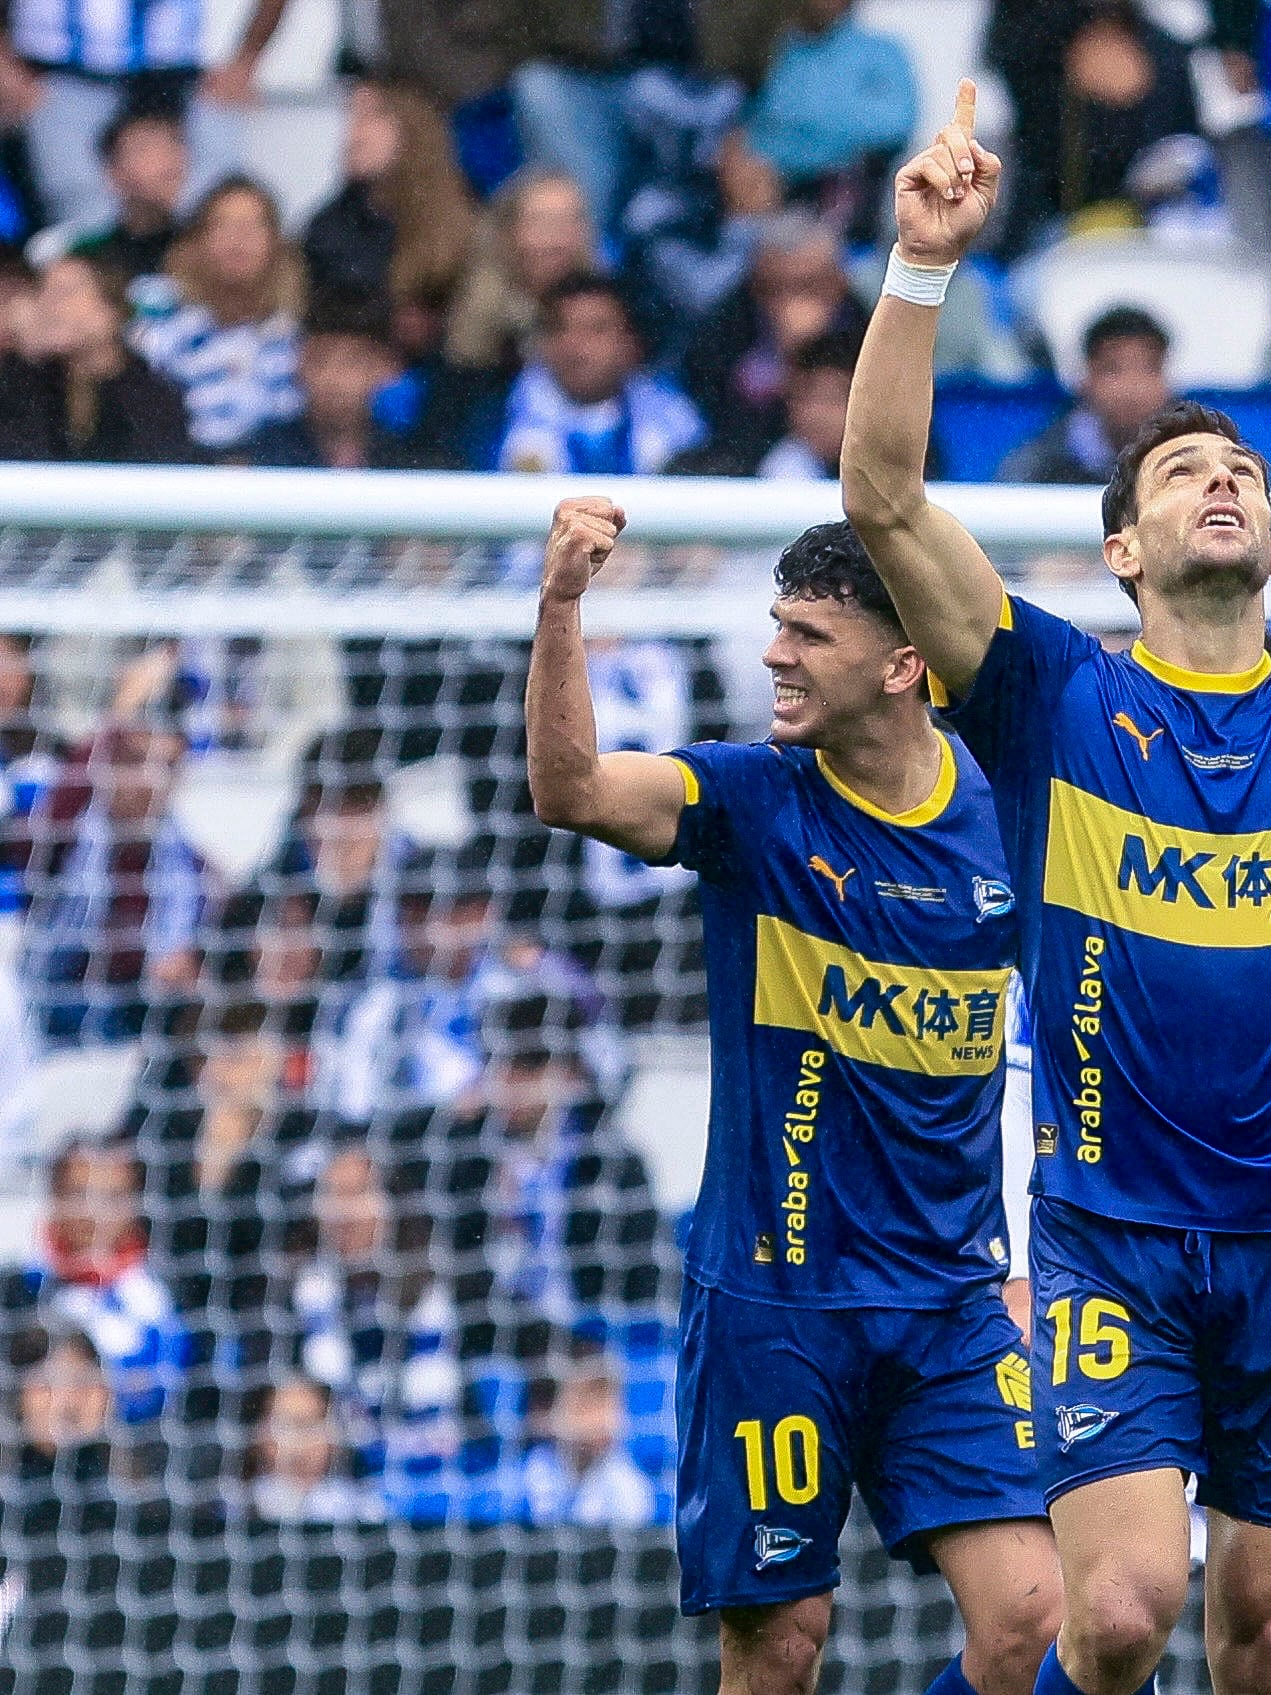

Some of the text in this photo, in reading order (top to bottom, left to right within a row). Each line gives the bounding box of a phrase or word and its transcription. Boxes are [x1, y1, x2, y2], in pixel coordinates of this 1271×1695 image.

[1118, 833, 1217, 910] MK
[818, 963, 1001, 1041] MK 体育
[951, 1044, 994, 1061] NEWS
[1073, 935, 1105, 1164] araba álava
[781, 1049, 826, 1266] araba álava
[1046, 1296, 1132, 1386] 15
[733, 1415, 819, 1511] 10
[1014, 1420, 1036, 1449] E
